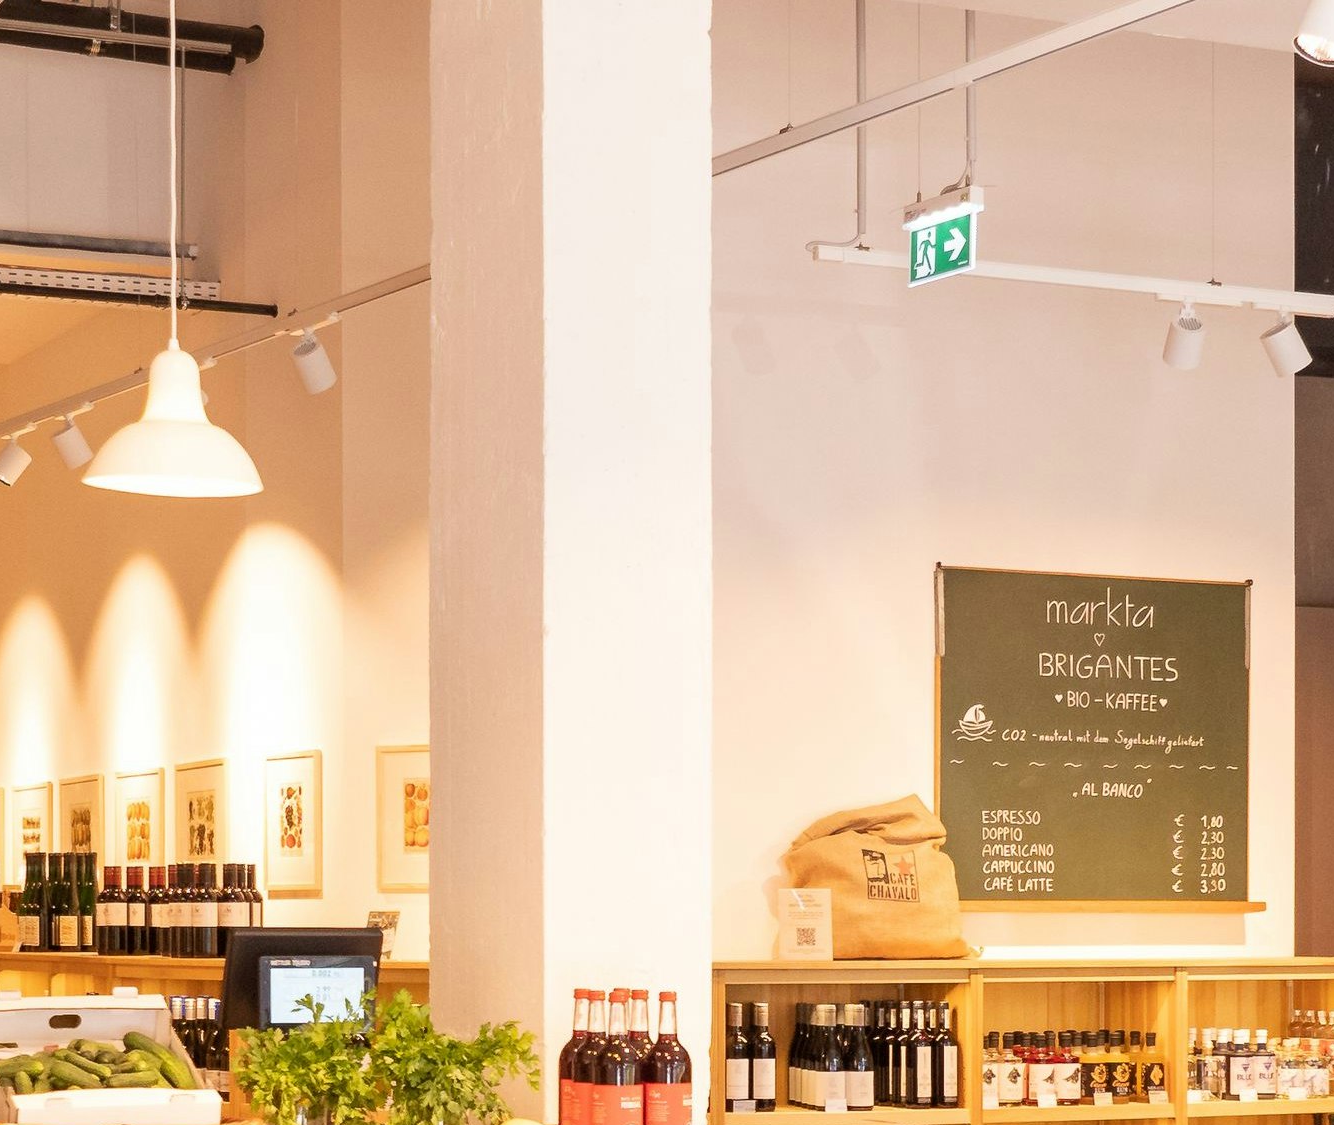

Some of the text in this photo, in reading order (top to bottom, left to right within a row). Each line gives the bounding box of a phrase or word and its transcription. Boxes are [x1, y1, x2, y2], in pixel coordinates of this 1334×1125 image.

[1046, 587, 1154, 628] markta
[1038, 652, 1179, 682] BRIGANTES
[1001, 728, 1027, 742] CO2
[1076, 730, 1091, 743] mit
[1093, 729, 1109, 743] dem
[981, 809, 1224, 830] ESPRESSO € 1,80
[982, 826, 1224, 846] DOPPIO € 2,30
[981, 843, 1225, 861] AMERICANO € 2,30
[982, 859, 1226, 878] CAPPUCCINO € 2,80
[869, 885, 917, 900] CHAVALO
[983, 875, 1014, 892] CAFÉ
[1017, 877, 1054, 893] LATTE
[1171, 879, 1183, 893] €
